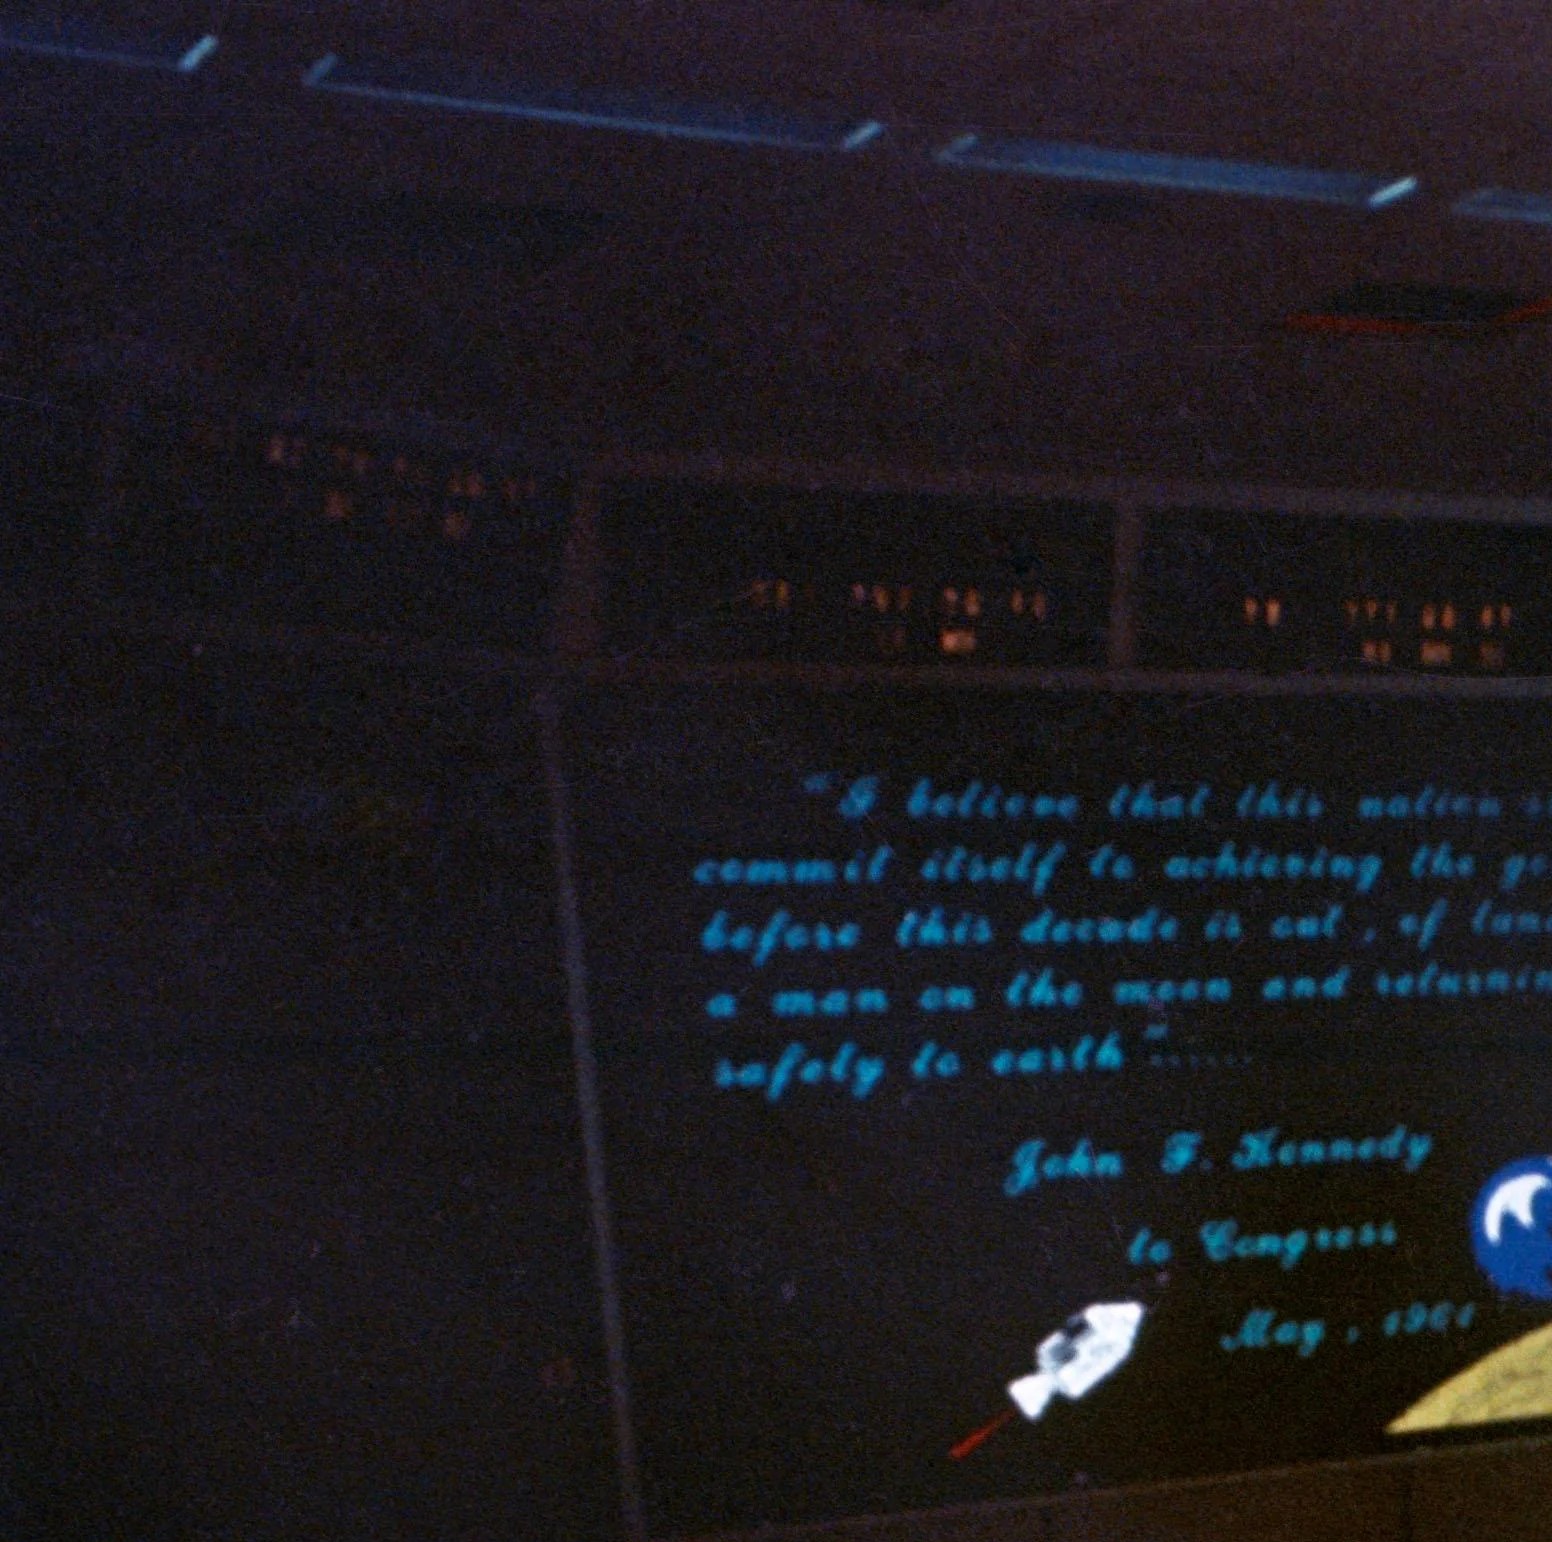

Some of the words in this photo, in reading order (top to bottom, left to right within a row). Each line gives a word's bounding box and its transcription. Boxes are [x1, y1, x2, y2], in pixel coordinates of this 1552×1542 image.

[1107, 783, 1211, 818] that
[694, 845, 893, 883] commit
[921, 841, 1066, 896] itself
[1089, 846, 1134, 880] to
[1410, 841, 1475, 878] the
[701, 909, 859, 966] before
[897, 906, 993, 947] this
[1020, 907, 1178, 943] decade
[1204, 910, 1242, 940] is
[1400, 899, 1447, 950] of
[706, 992, 736, 1018] a
[772, 988, 888, 1016] man
[918, 985, 975, 1010] on
[1005, 969, 1082, 1007] the
[1114, 980, 1231, 1004] moon
[1261, 965, 1352, 999] and
[713, 1041, 885, 1100] safely
[911, 1041, 960, 1079] to
[1003, 1136, 1123, 1196] John
[1233, 1124, 1433, 1172] Kennedy
[1127, 1227, 1173, 1266] to
[1200, 1218, 1398, 1270] Congress
